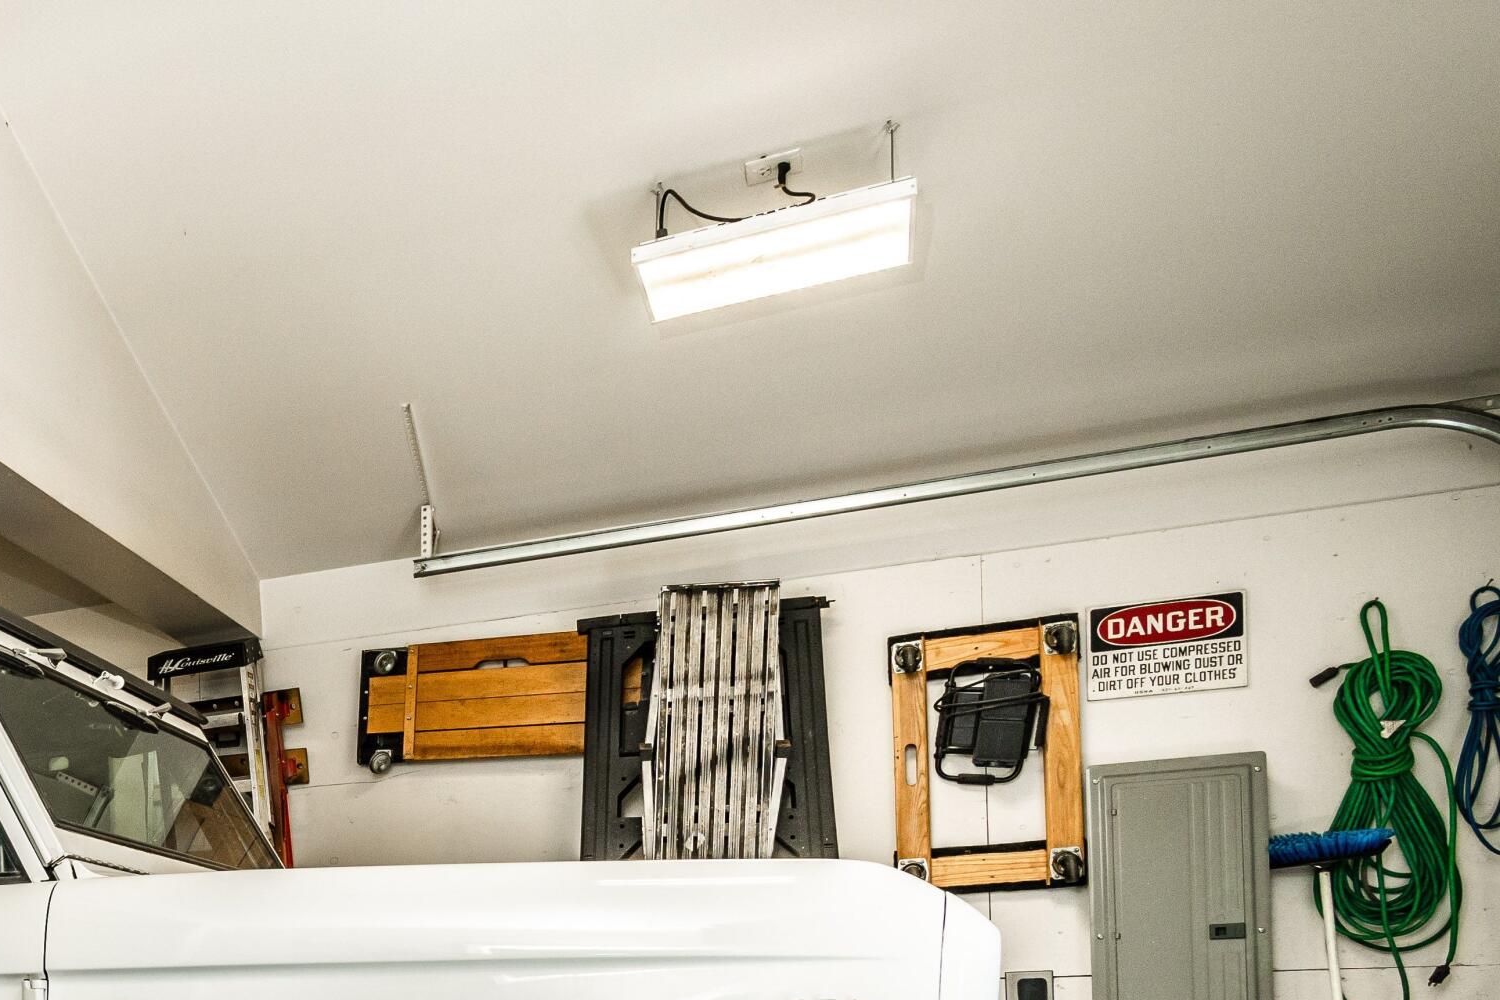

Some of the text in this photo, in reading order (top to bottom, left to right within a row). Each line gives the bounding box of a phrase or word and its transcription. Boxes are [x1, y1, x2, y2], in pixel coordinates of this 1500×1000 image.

[1107, 606, 1224, 640] DANGER
[159, 653, 235, 674] Louisville
[1091, 653, 1243, 680] AIR FOR BLOWING DUST OR
[1092, 640, 1241, 667] DO NOT USE COMPRESSED
[1098, 679, 1123, 693] DIRT
[1126, 677, 1146, 689] OFF
[1149, 674, 1180, 687] YOUR
[1184, 668, 1237, 683] CLOTHES
